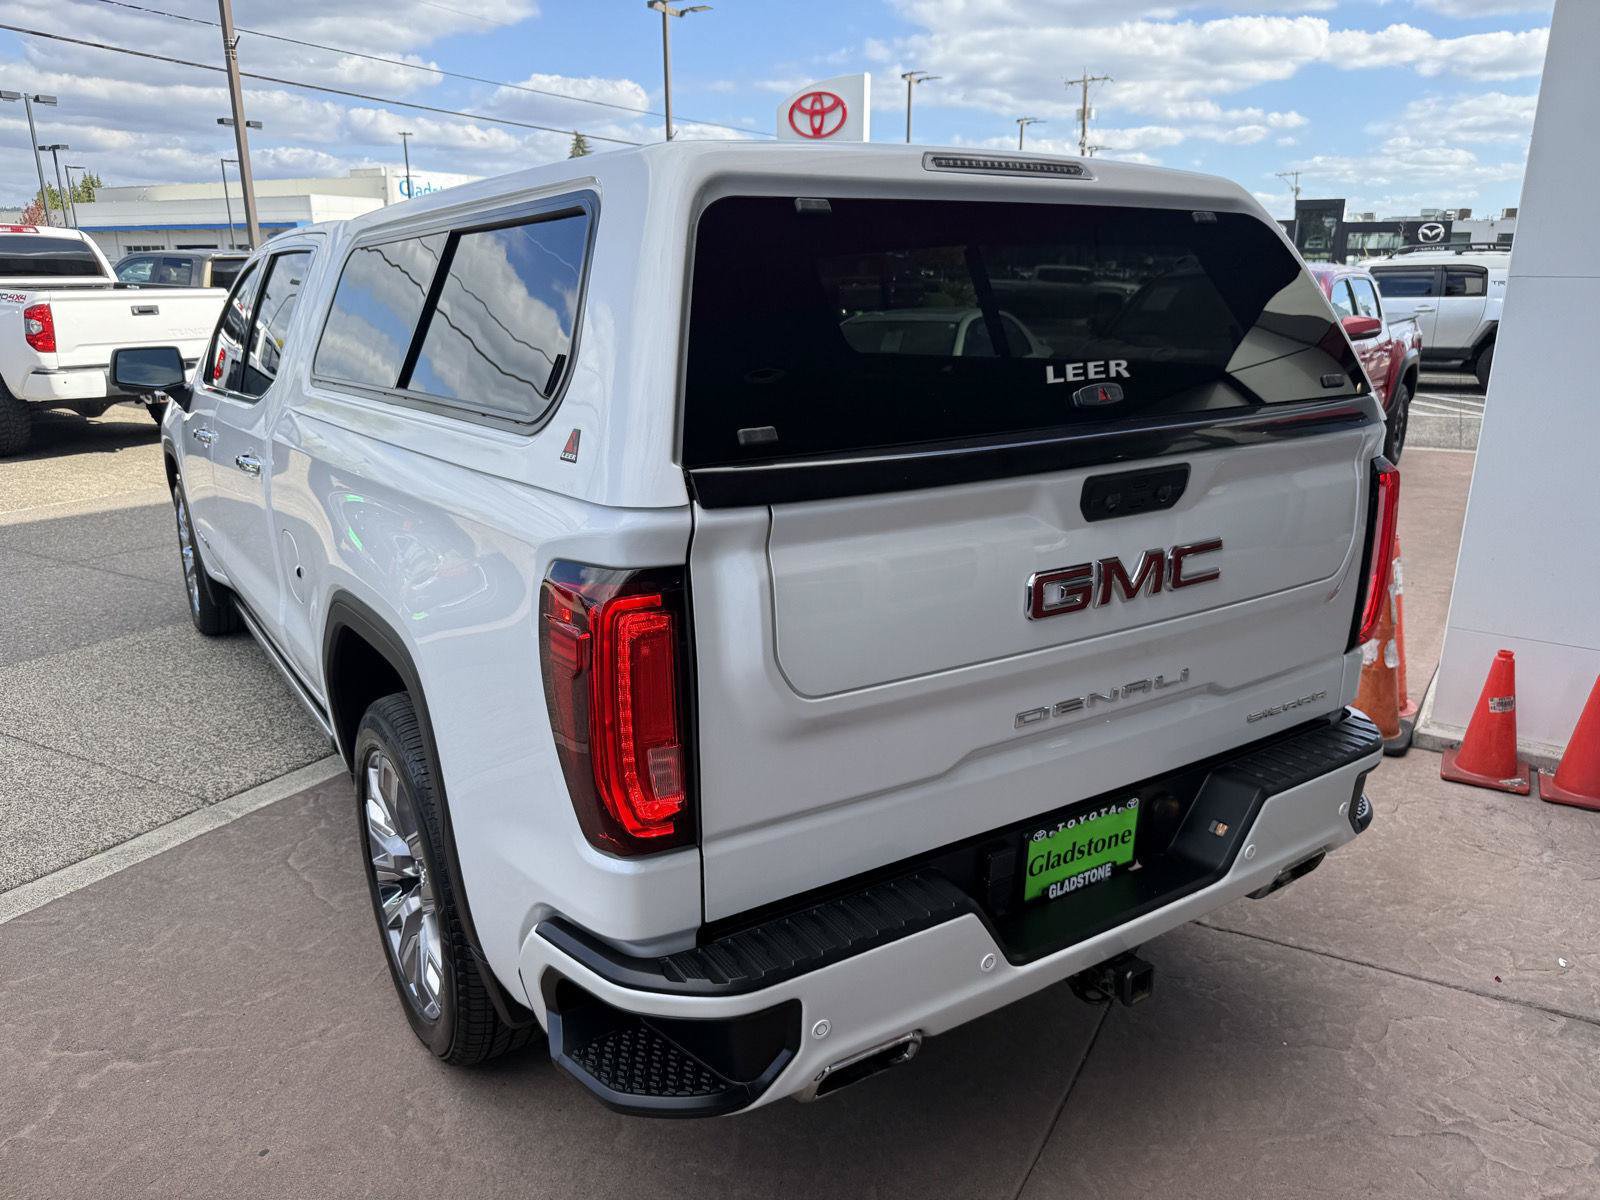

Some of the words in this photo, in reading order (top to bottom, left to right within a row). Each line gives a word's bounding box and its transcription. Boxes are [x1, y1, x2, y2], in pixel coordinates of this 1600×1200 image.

[1046, 360, 1131, 384] LEER
[561, 452, 577, 461] LEER
[1023, 536, 1223, 621] GMC
[1014, 667, 1189, 729] DENALI
[1057, 804, 1117, 832] TOYOTA
[1028, 828, 1133, 877] Gladstone
[1048, 862, 1113, 899] GLADSTONE
